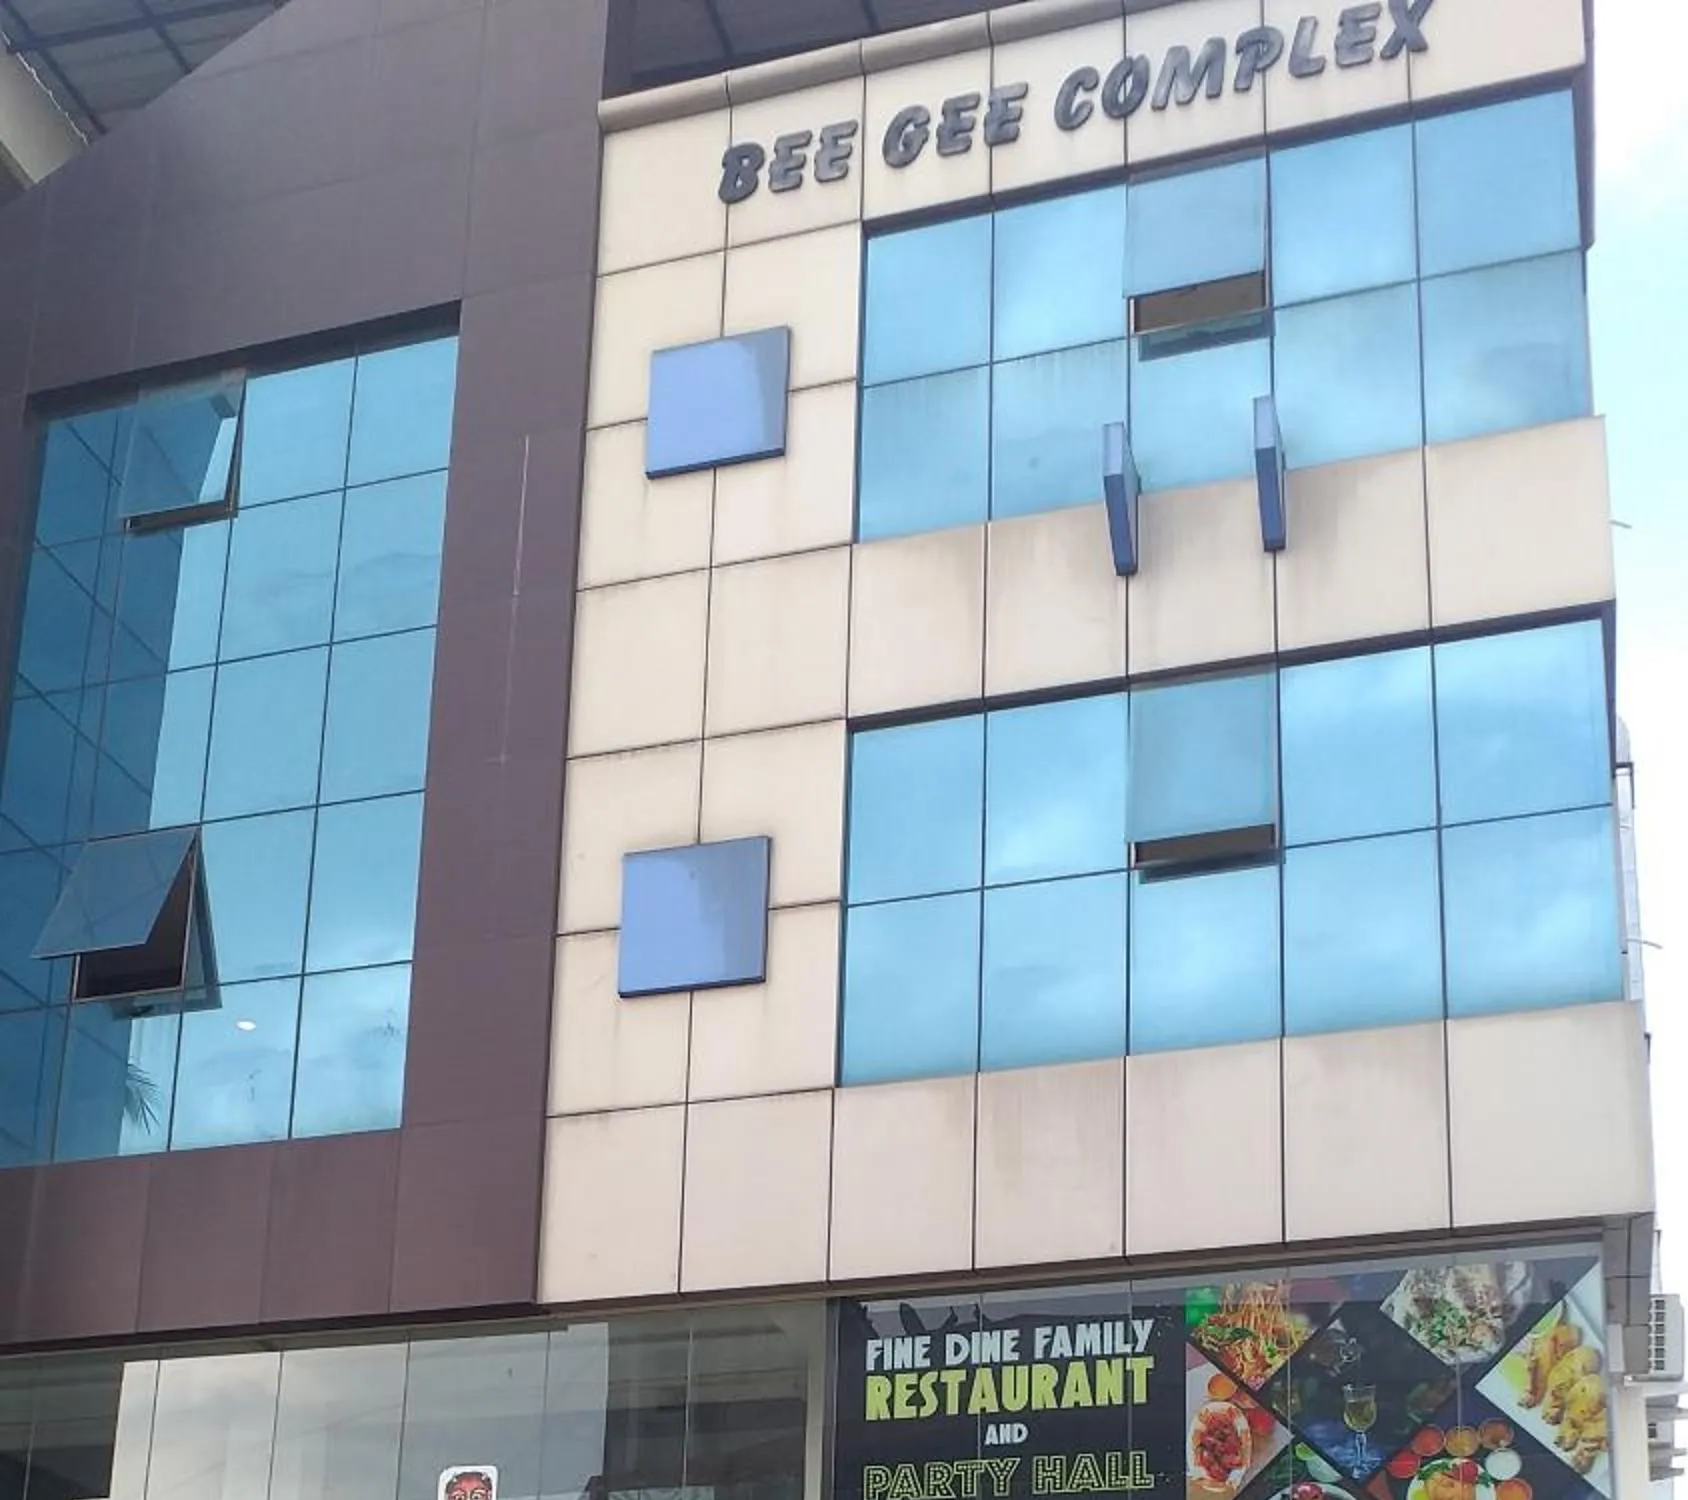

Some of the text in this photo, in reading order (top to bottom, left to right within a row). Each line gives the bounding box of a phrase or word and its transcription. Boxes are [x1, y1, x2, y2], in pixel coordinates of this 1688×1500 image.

[718, 0, 1436, 204] BEE GEE COMPLEX
[866, 1319, 1154, 1371] FINE DINE FAMILY
[865, 1356, 1154, 1421] RESTAURANT
[984, 1423, 1028, 1446] AND
[1032, 1451, 1155, 1494] HALL
